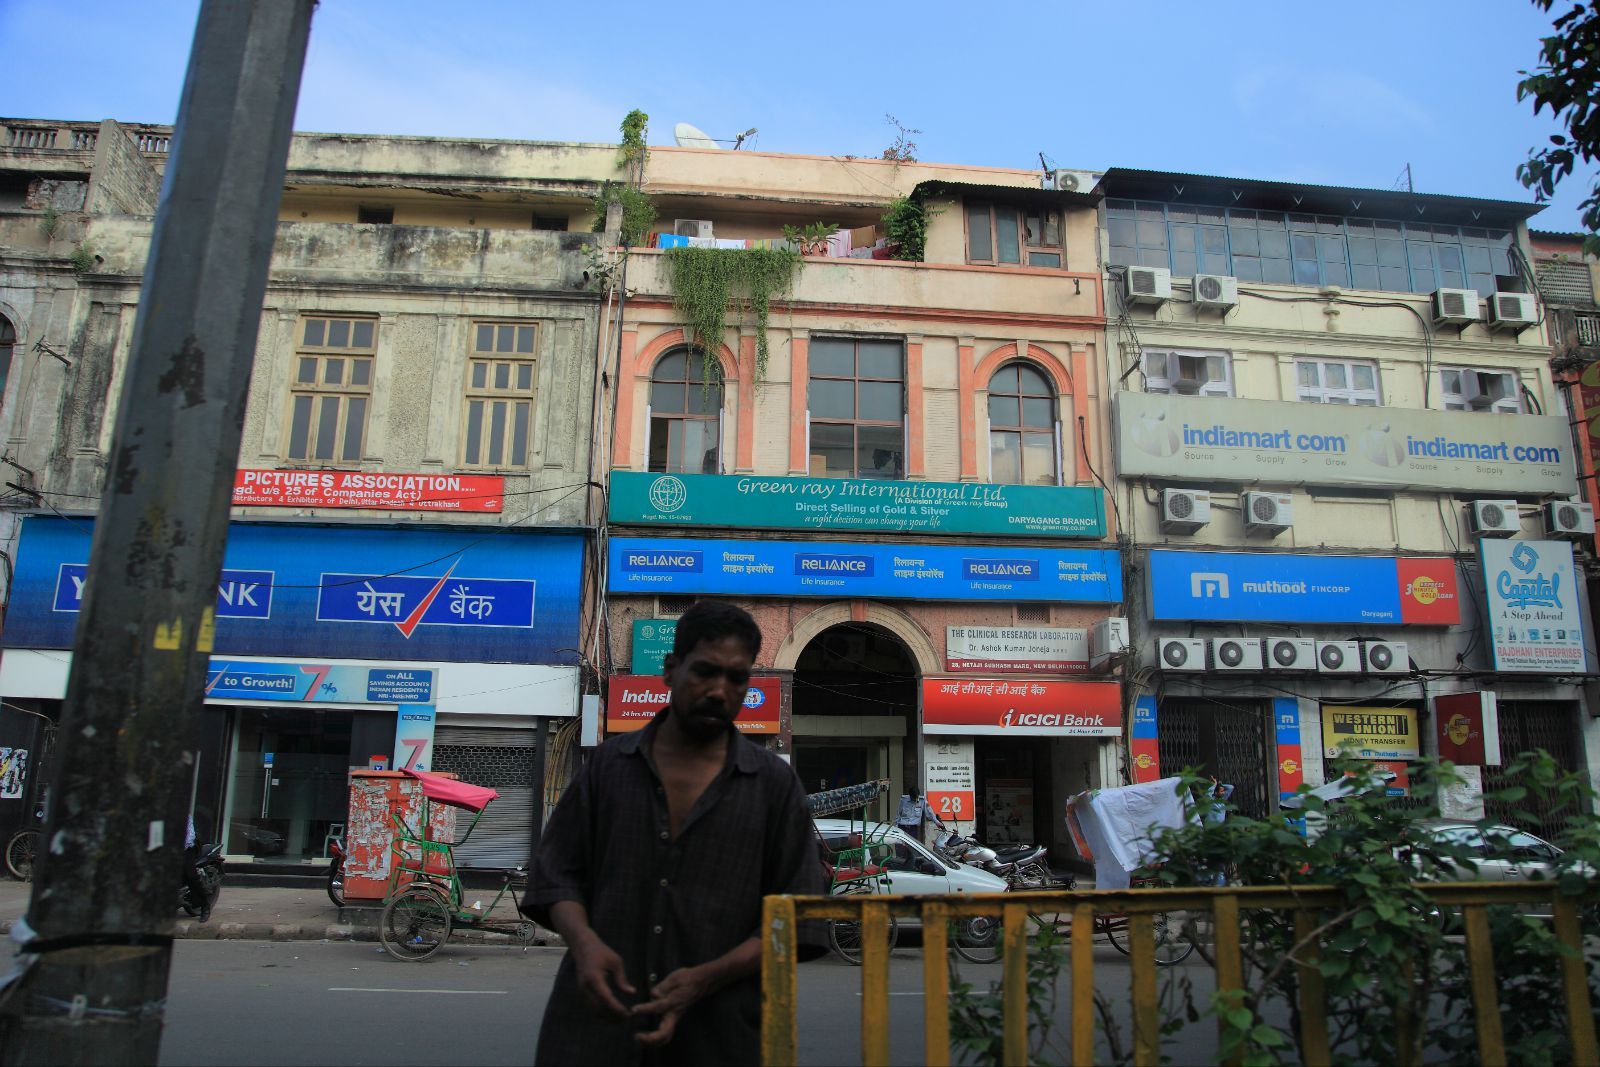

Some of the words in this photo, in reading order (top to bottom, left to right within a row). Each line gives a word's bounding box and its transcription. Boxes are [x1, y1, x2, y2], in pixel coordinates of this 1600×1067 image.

[1255, 454, 1285, 464] Supply
[1476, 465, 1502, 476] Supply
[1541, 468, 1562, 477] Grow
[244, 471, 335, 488] PICTURES
[262, 486, 280, 495] u/s
[285, 486, 302, 496] 25
[305, 487, 317, 496] of
[323, 488, 391, 499] Companies
[395, 490, 422, 500] Act)
[737, 478, 798, 494] Green
[801, 482, 836, 499] ray
[839, 481, 970, 500] International
[970, 485, 1006, 501] Ltd.
[287, 496, 323, 504] Exhibitors
[904, 497, 932, 505] Division
[983, 501, 1008, 509] Group)
[795, 502, 828, 512] Direct
[830, 503, 867, 514] Selling
[869, 504, 880, 514] of
[882, 505, 907, 515] Gold
[910, 506, 918, 515] &
[920, 506, 949, 516] Silver
[812, 512, 832, 527] right
[833, 512, 863, 524] decision
[864, 517, 879, 525] can
[880, 514, 907, 530] change
[908, 519, 930, 530] your
[930, 515, 941, 528] life
[1062, 517, 1097, 526] BRANCH
[629, 573, 640, 581] Life
[641, 574, 672, 582] Insurance
[801, 577, 813, 585] Life
[814, 577, 845, 586] Insurance
[983, 582, 1012, 590] Insurance
[1242, 580, 1307, 593] muthoot
[1311, 585, 1350, 593] FINCORP
[1405, 583, 1413, 595] 3
[1496, 569, 1563, 610] Capital
[218, 582, 258, 607] NK
[357, 581, 405, 617] येस
[449, 584, 495, 619] बैंक
[1501, 611, 1508, 619] A
[1511, 610, 1531, 621] Step
[1534, 610, 1564, 621] Ahead
[659, 624, 677, 635] Gre
[951, 629, 965, 638] THE
[967, 629, 999, 639] CLINICAL
[1001, 630, 1037, 640] RESEARCH
[1039, 631, 1082, 641] LABORATORY
[968, 644, 978, 652] Dr.
[980, 644, 1002, 652] Ashok
[1004, 644, 1026, 652] Kumar
[1497, 646, 1533, 657] RAJDHANI
[1534, 647, 1582, 658] ENTERPRISES
[396, 672, 414, 680] ALL
[224, 677, 238, 686] to
[242, 676, 293, 689] Growth!
[1030, 683, 1047, 696] बैंक
[1018, 713, 1060, 726] ICICI
[1063, 714, 1104, 726] Bank
[1334, 713, 1396, 724] WESTERN
[1353, 724, 1396, 734] UNION
[940, 796, 962, 813] 28
